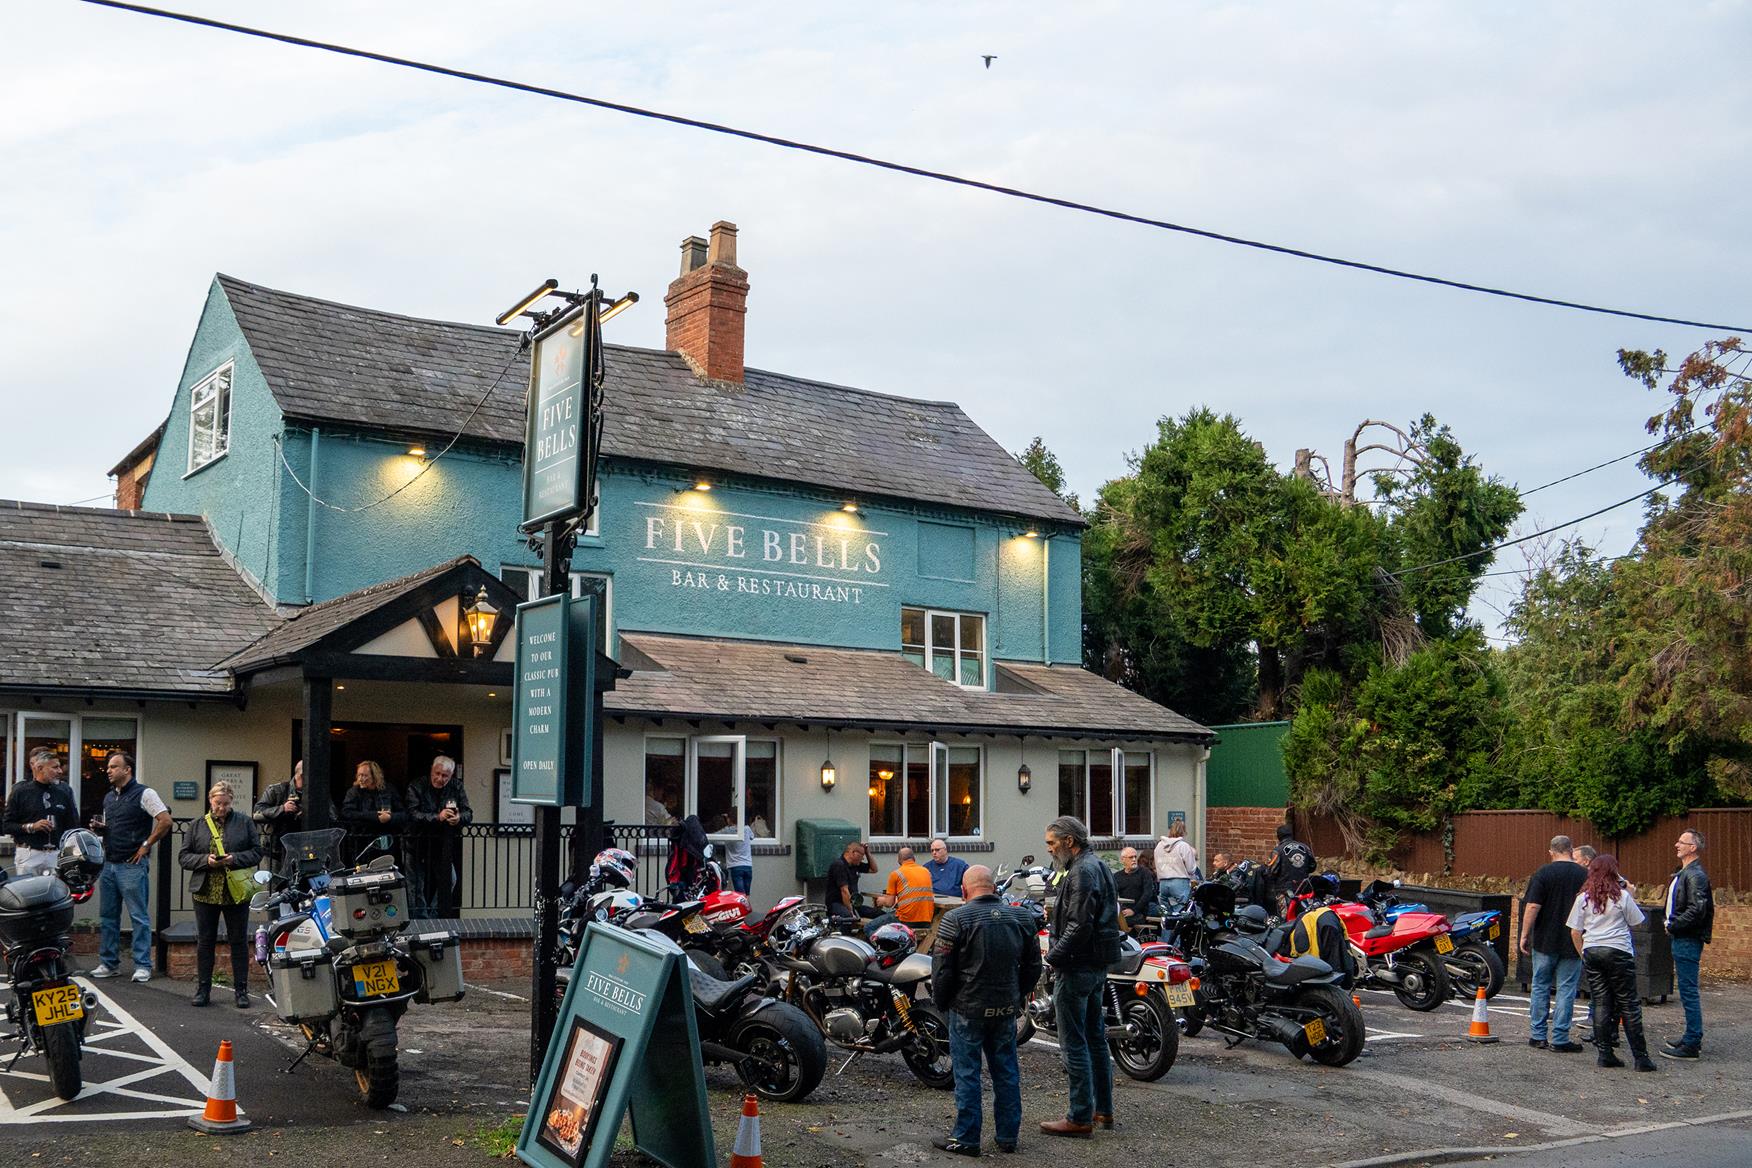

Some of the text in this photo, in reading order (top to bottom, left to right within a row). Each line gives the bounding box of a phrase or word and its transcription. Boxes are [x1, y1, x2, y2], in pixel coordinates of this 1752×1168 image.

[543, 397, 572, 432] FIVE
[537, 424, 575, 462] BELLS
[645, 517, 881, 573] FIVE BELLS
[672, 569, 862, 604] BAR & RESTAURANT
[529, 632, 556, 645] WELCOME
[531, 651, 552, 662] TO OUR
[524, 668, 559, 682] CLASSIC PUB
[530, 688, 551, 698] WITH A
[528, 705, 552, 717] MODERN
[529, 724, 549, 734] CHARM
[523, 760, 555, 770] OPEN DAILY
[718, 907, 741, 921] GIVI
[362, 965, 386, 978] V21
[365, 977, 396, 993] NGX
[35, 988, 77, 1007] KY25
[587, 974, 610, 997] FIVE
[612, 985, 644, 1011] BELLS
[45, 1004, 74, 1020] JHL
[984, 1005, 1015, 1017] BKS
